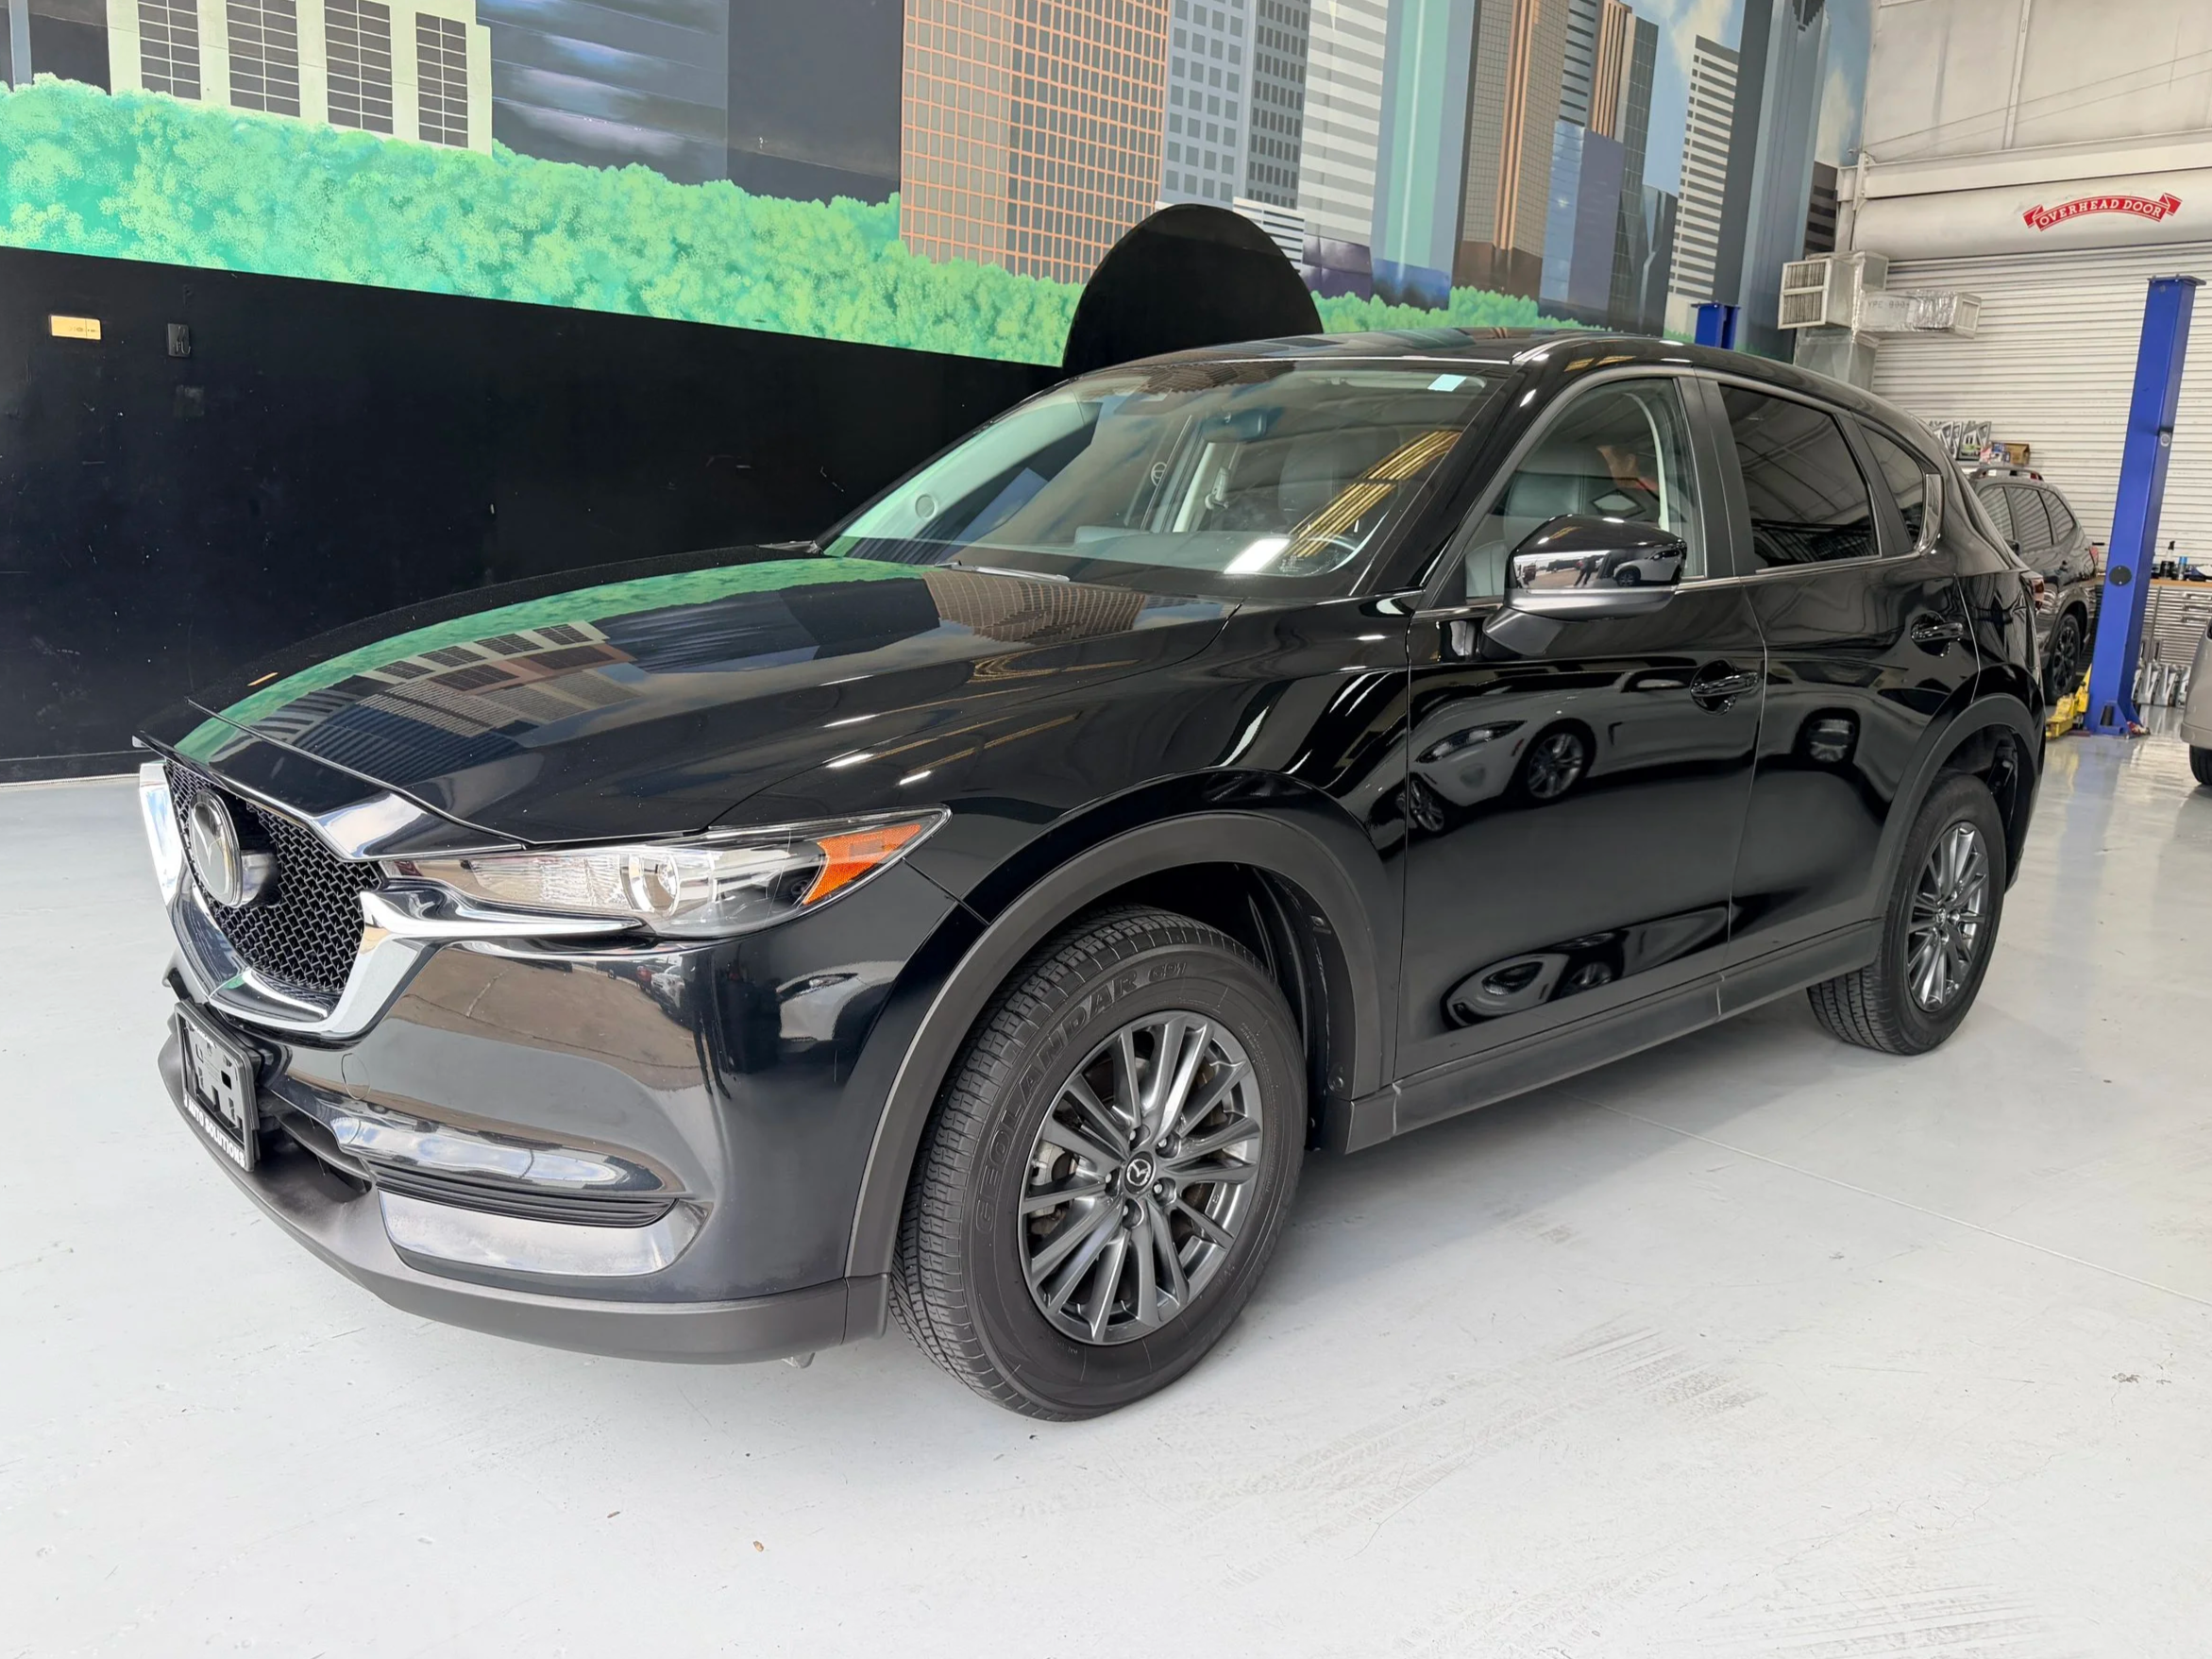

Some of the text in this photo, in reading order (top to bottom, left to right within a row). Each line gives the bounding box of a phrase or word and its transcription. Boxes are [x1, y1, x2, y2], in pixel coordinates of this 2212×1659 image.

[2039, 199, 2162, 226] OVERHEAD DOOR
[188, 1098, 205, 1126] AUTO
[205, 1117, 245, 1167] SOLUTIONS
[975, 971, 1138, 1231] GEOLANDAR
